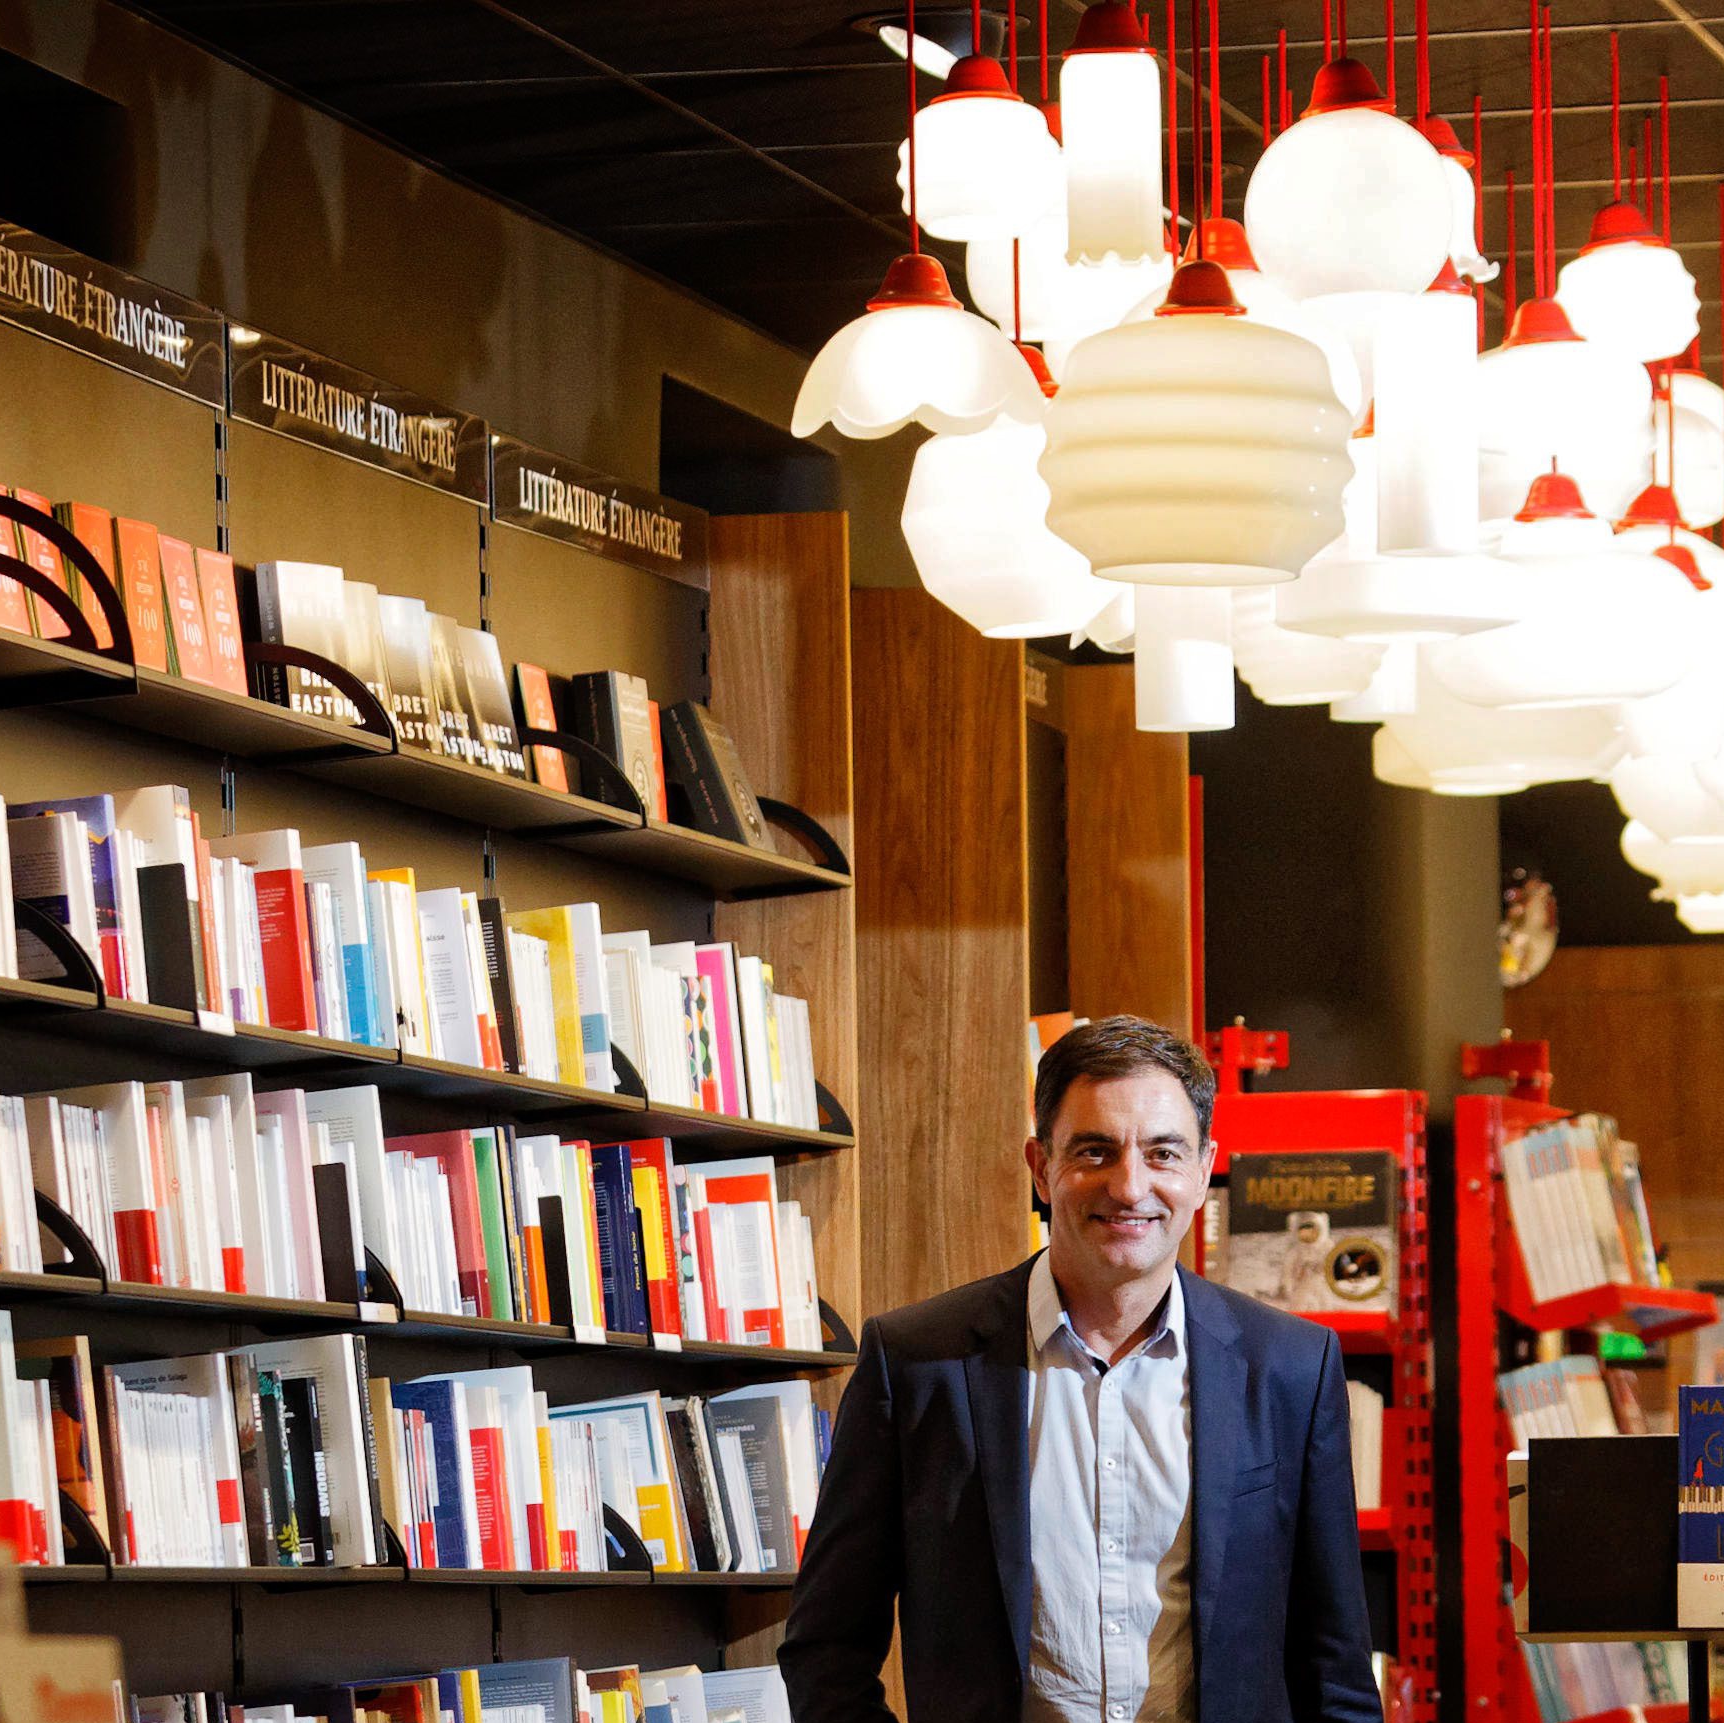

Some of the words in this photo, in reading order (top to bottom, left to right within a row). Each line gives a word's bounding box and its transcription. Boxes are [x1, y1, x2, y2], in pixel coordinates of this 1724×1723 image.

[83, 271, 186, 369] ÉTRANGÈRE
[262, 360, 366, 442] LITTÉRATURE
[371, 392, 457, 472] ÉTRANGÈRE
[519, 466, 607, 532] LITTÉRATURE
[610, 489, 683, 560] ÉTRANGÈRE
[483, 722, 513, 745] BRET
[1245, 1174, 1376, 1204] MOONFIRE
[313, 1450, 332, 1517] SWOOSH
